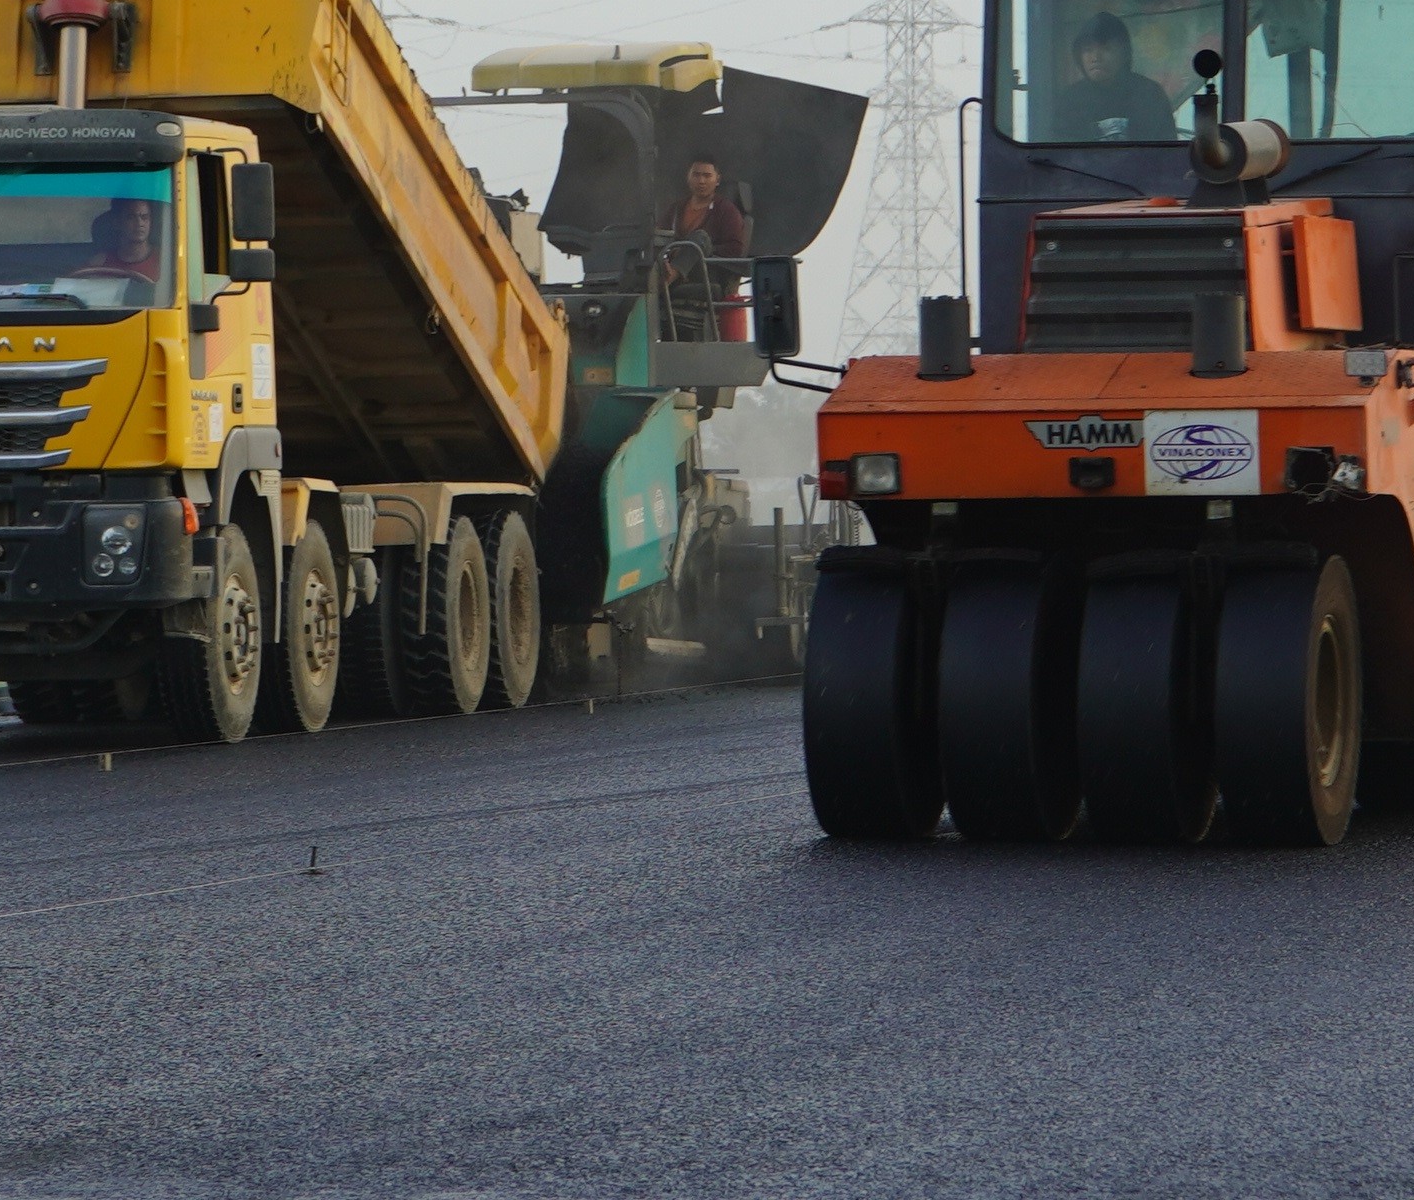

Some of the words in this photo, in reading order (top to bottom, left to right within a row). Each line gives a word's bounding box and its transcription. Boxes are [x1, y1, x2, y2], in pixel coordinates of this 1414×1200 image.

[72, 127, 135, 138] HONGYAN
[1047, 423, 1135, 444] HAMM
[1158, 447, 1247, 457] VINACONEX
